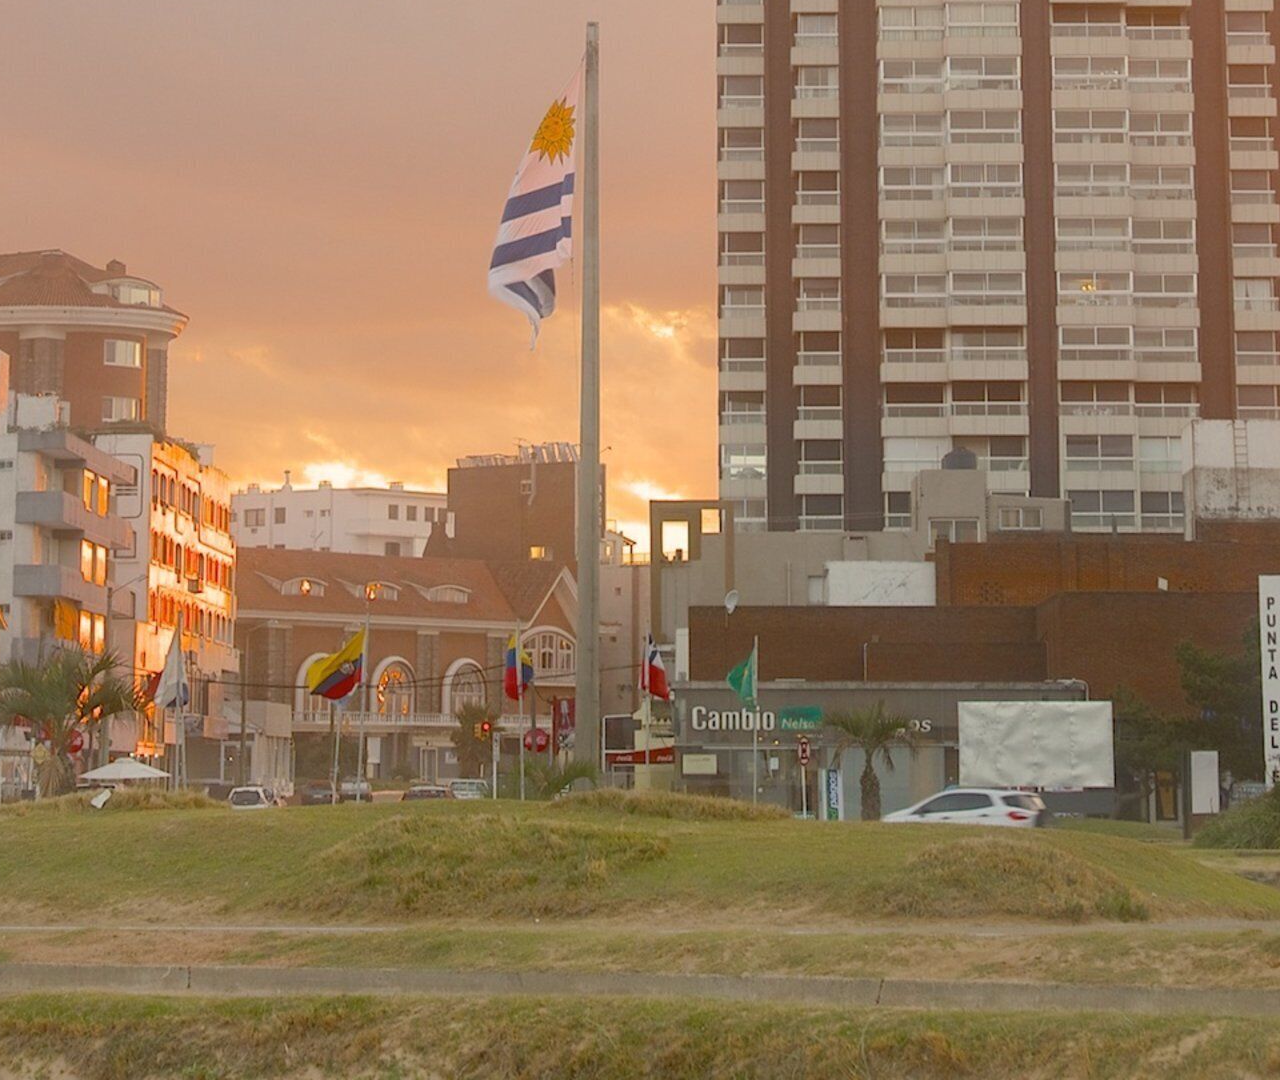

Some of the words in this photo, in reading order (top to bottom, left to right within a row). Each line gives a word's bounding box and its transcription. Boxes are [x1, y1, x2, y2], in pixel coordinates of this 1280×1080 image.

[1266, 596, 1278, 680] PUNTA
[691, 705, 775, 731] Cambio
[1270, 700, 1279, 749] DEL
